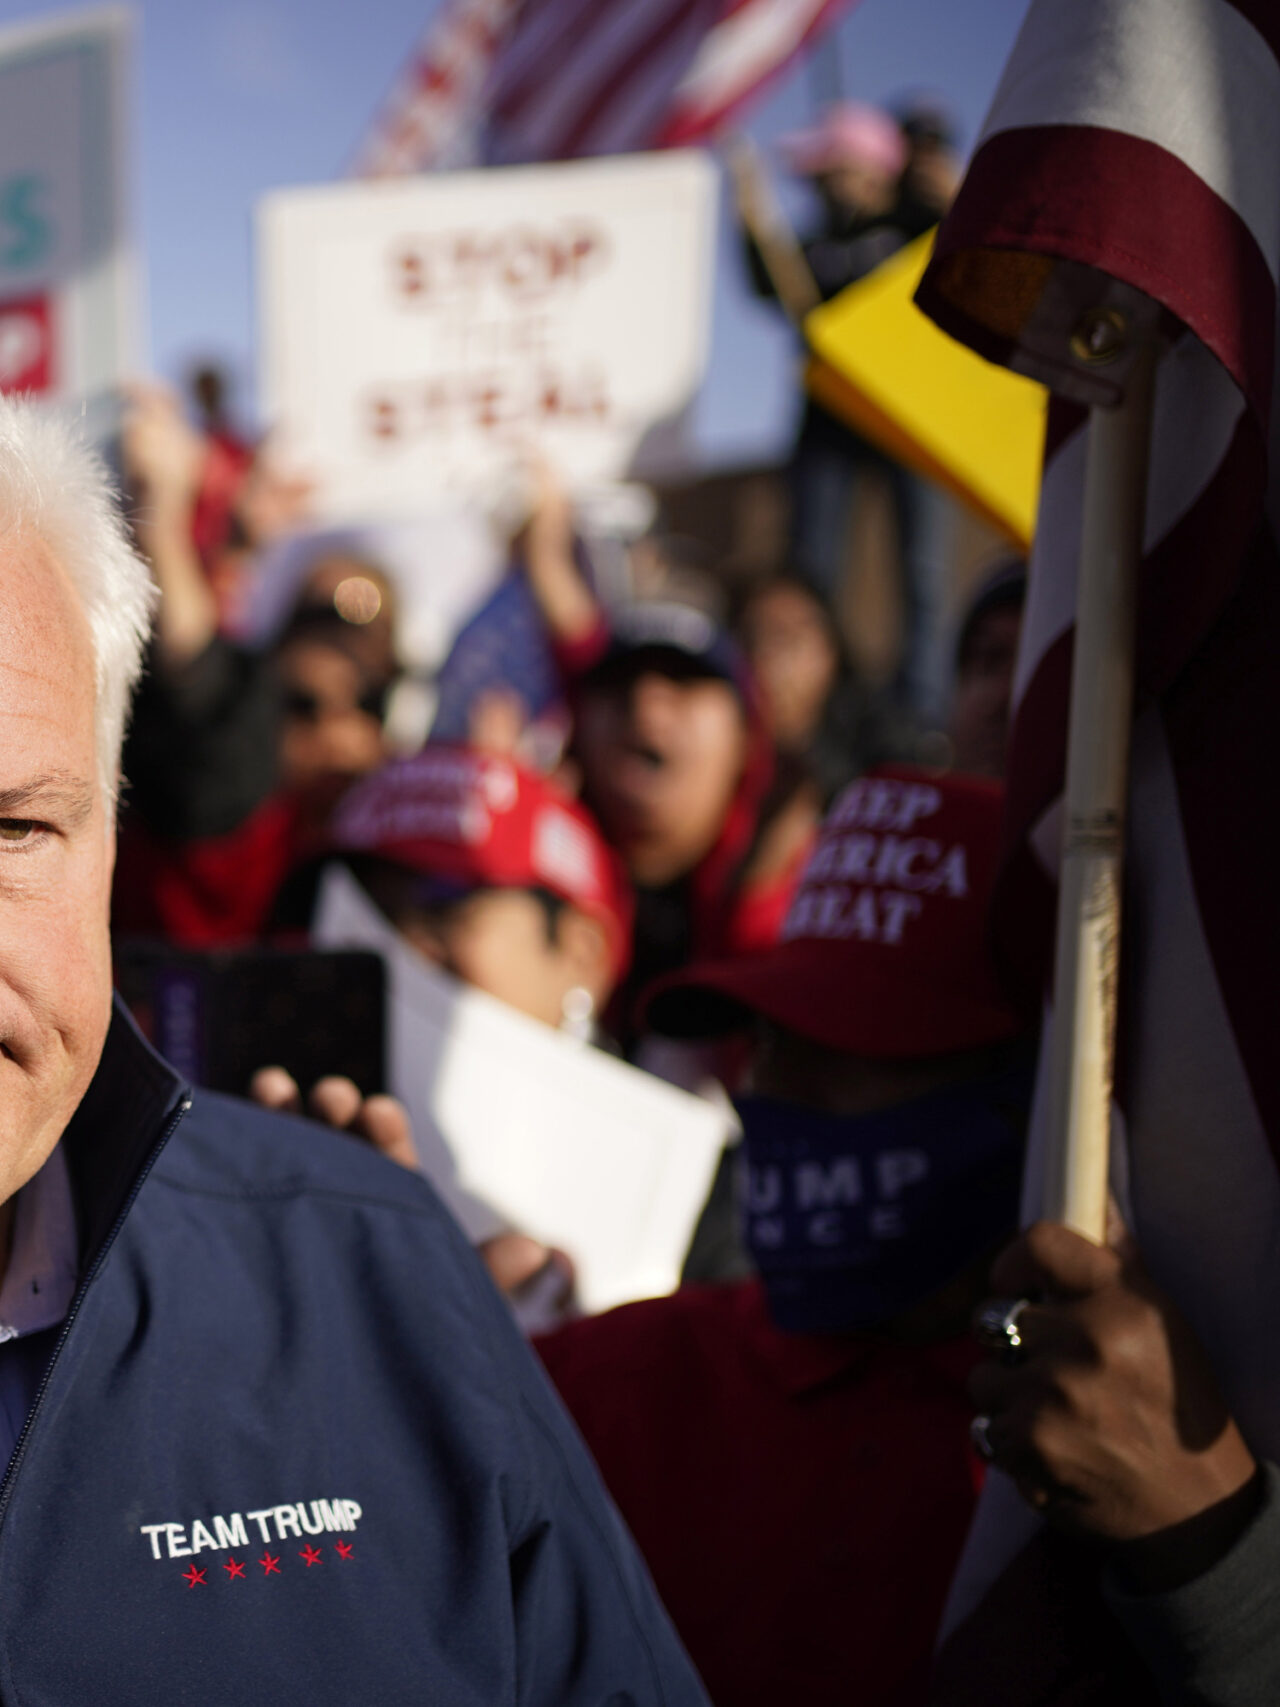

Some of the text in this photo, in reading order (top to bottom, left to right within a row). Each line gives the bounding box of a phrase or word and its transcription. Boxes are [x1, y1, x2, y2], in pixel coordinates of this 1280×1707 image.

[390, 222, 606, 306] STOP
[370, 366, 612, 444] STEAL
[140, 1498, 363, 1560] TEAM TRUMP
